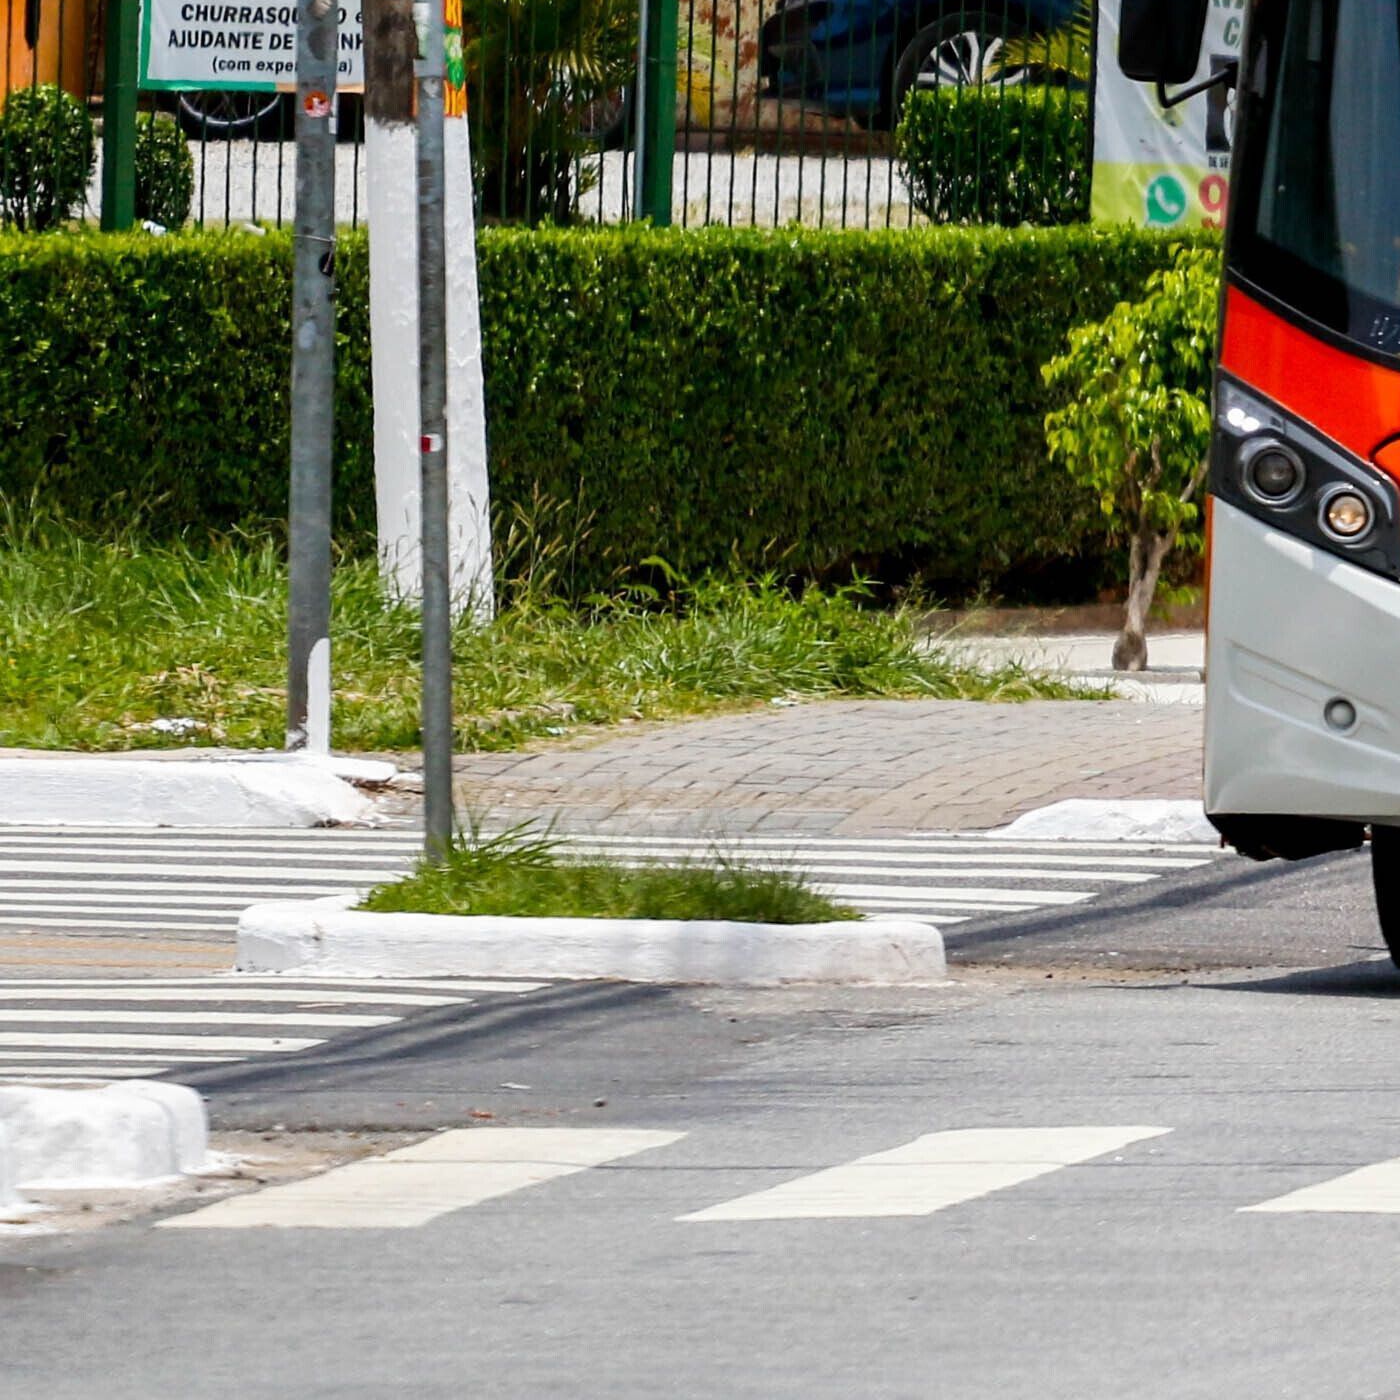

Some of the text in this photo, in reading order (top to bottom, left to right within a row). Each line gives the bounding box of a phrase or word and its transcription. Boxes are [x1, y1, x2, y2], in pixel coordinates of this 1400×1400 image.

[168, 29, 293, 50] AJUDANTE DE
[212, 56, 250, 74] (com
